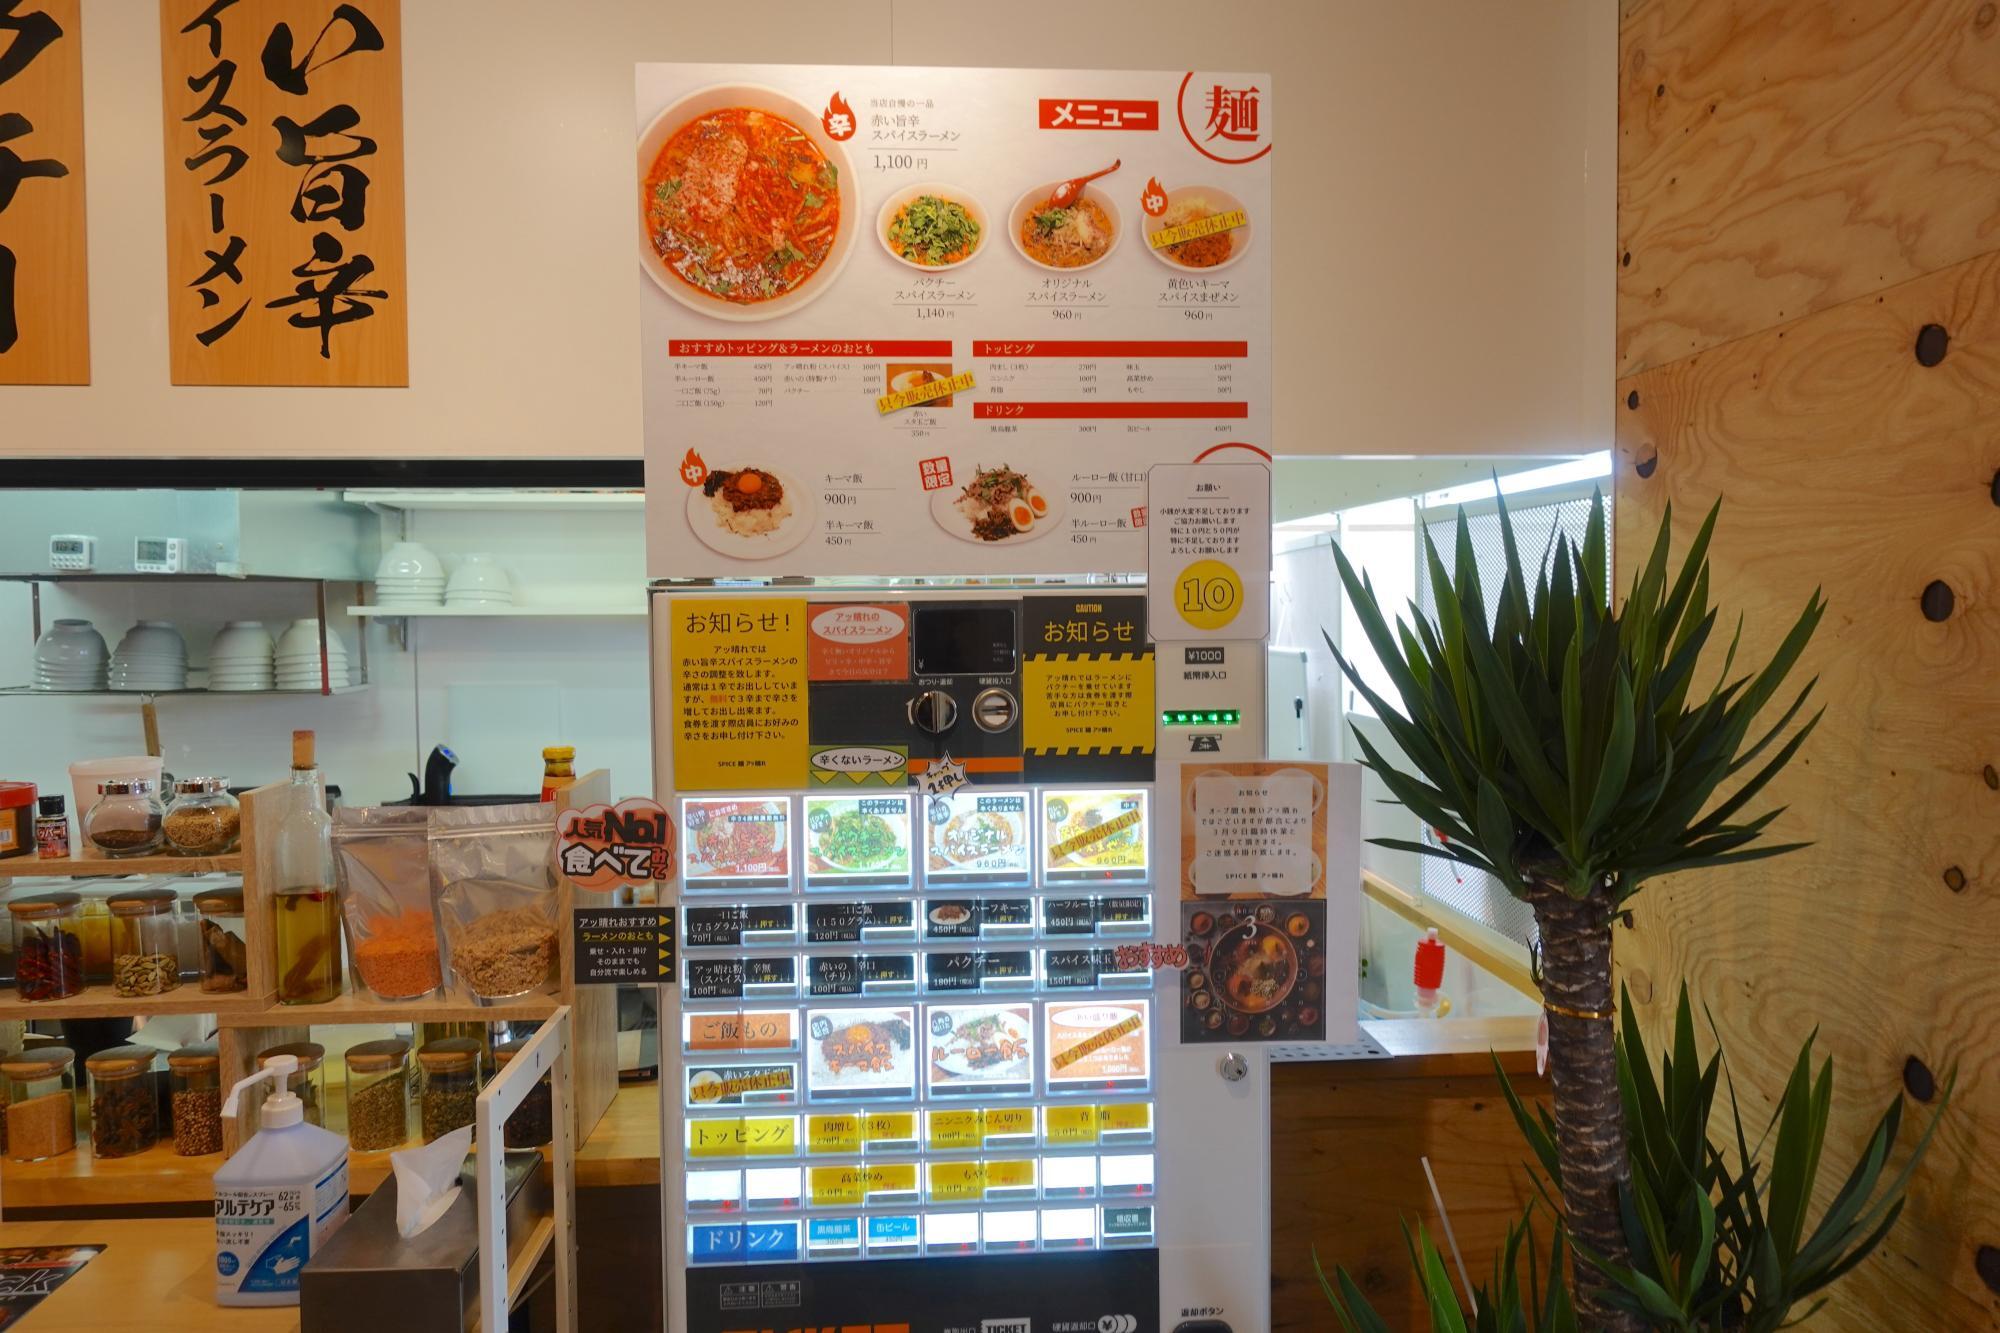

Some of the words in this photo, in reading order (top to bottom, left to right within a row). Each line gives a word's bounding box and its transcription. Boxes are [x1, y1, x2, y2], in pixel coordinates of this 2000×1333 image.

[1051, 101, 1148, 127] メニュー
[1204, 84, 1261, 142] 麺
[829, 113, 851, 136] 辛
[871, 114, 920, 128] 赤い旨辛
[871, 129, 961, 142] スパイスラーメン
[1146, 194, 1164, 213] 中
[913, 277, 957, 288] パクチー
[1041, 279, 1093, 289] オリジナル
[1168, 278, 1230, 290] 黄色いキーマ
[895, 290, 977, 301] スパイスラーメン
[1027, 291, 1107, 302] スパイスラーメン
[1159, 292, 1239, 303] スパイスまぜメン
[984, 342, 1036, 355] トッピング
[986, 404, 1025, 417] ドリンク
[824, 473, 864, 484] キーマ飯
[1195, 483, 1222, 493] お願い
[825, 519, 875, 531] 半キーマ飯
[1071, 518, 1127, 529] 半ルーロー飯
[1170, 536, 1240, 545] 特に不足しております
[1170, 546, 1240, 555] よろしくお願いします
[1183, 576, 1236, 613] 10
[1075, 603, 1103, 614] CAUTION
[835, 612, 880, 623] アッ晴れの
[823, 625, 893, 636] スパイスラーメン
[1044, 620, 1136, 643] お知らせ
[713, 645, 768, 654] アッ晴れでは
[682, 657, 799, 667] 赤い旨辛スパイスラーメンの
[684, 730, 786, 742] 辛さをお申し付け下さい。
[819, 754, 904, 767] 辛くないラーメン
[1239, 789, 1269, 797] お知らせ
[947, 828, 1008, 841] オリジナル
[930, 844, 1026, 856] スパイスラーメン
[562, 843, 651, 879] 食べて
[579, 916, 657, 928] アッ晴れおすすめ
[1242, 915, 1258, 940] 3
[582, 931, 654, 942] ラーメンのおとも
[692, 933, 712, 943] 70円
[815, 931, 839, 941] 120円
[596, 957, 640, 966] そのままでも
[946, 955, 1001, 969] パクチー
[1115, 942, 1189, 970] おすすめ
[589, 966, 648, 977] 自分流で楽しめる
[694, 963, 743, 975] アッ晴れ粉
[818, 961, 848, 972] 赤いの
[692, 985, 717, 996] 100円
[812, 983, 837, 994] 100円
[703, 1022, 778, 1041] ご飯もの
[931, 1038, 1030, 1062] ルーロー飯
[934, 1113, 1023, 1126] ニンニクみじん切り
[698, 1124, 790, 1147] トッピング
[215, 1199, 275, 1217] アルテケア
[876, 1222, 911, 1233] 缶ビール
[708, 1229, 785, 1251] ドリンク
